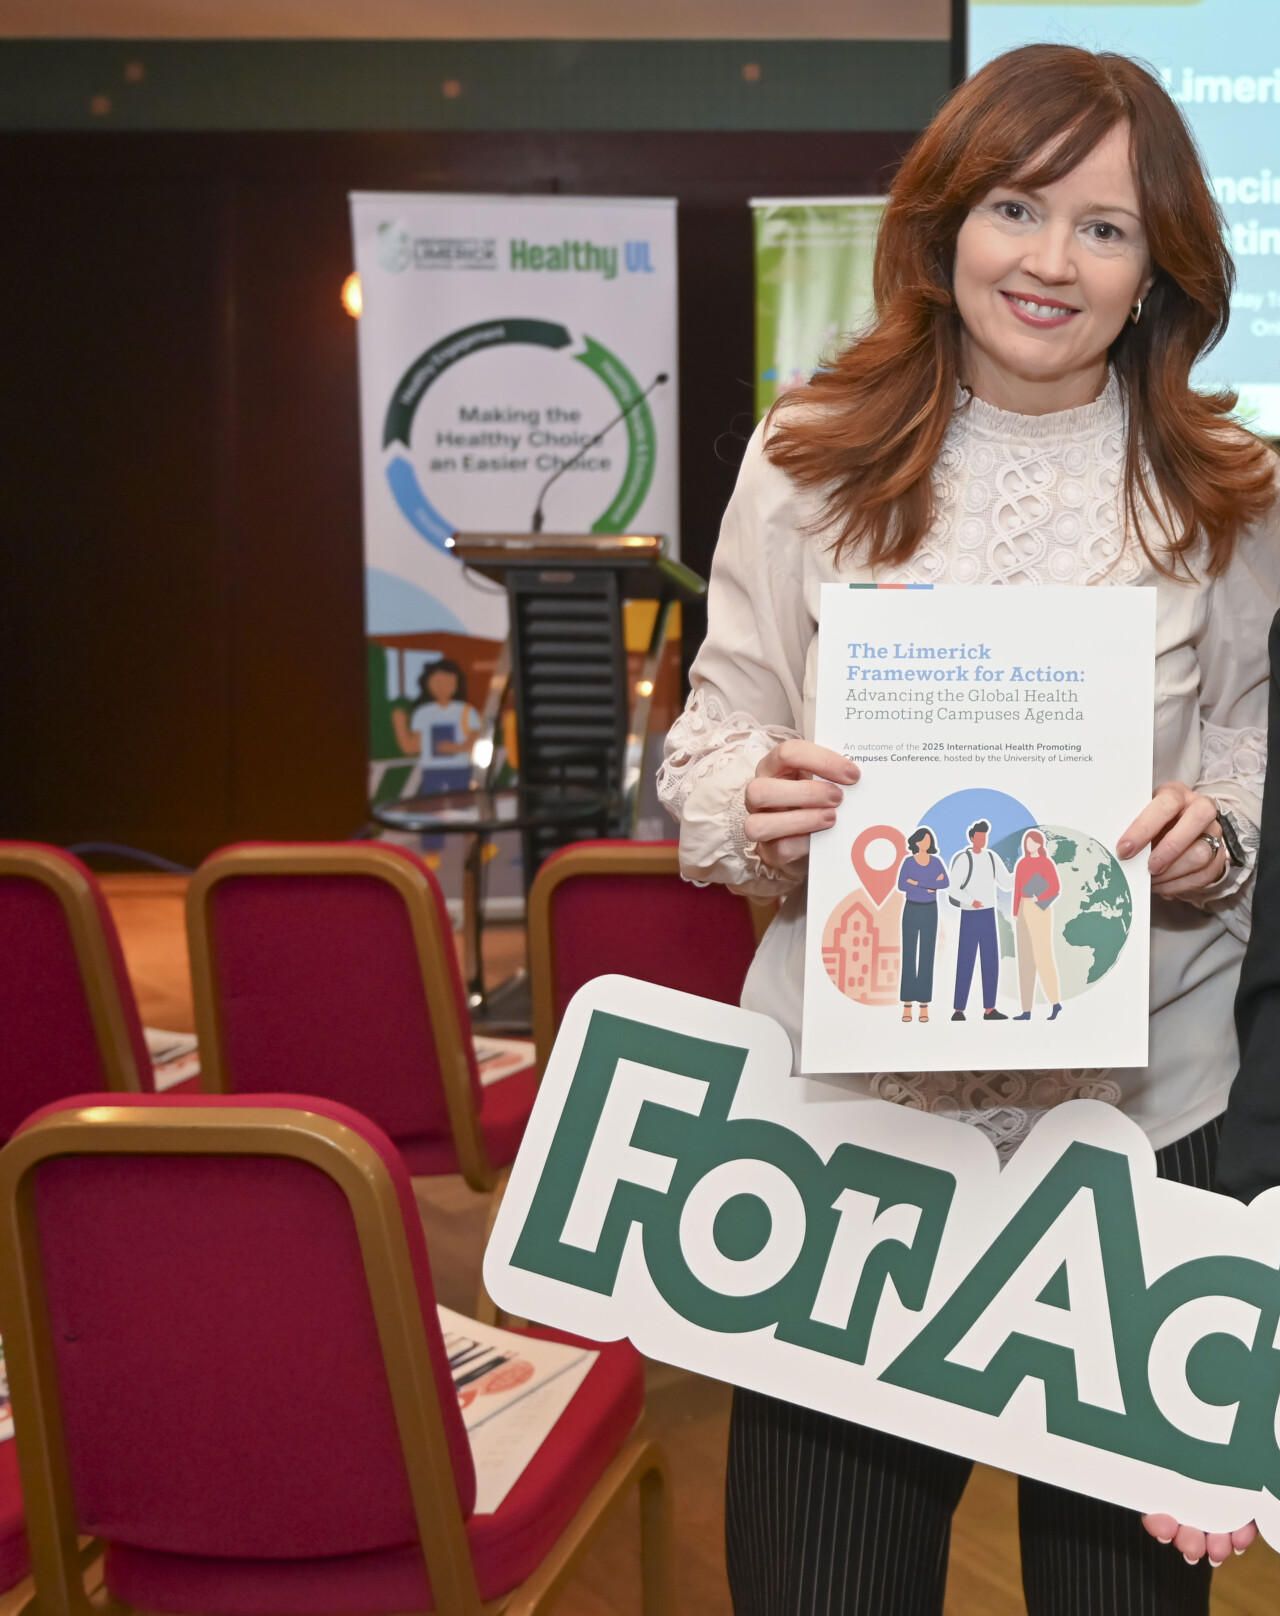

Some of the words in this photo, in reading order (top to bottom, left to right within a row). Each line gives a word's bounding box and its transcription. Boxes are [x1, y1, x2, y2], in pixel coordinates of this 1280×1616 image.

[509, 239, 618, 280] Healthy
[624, 240, 656, 272] UL
[458, 407, 540, 426] Making
[546, 406, 581, 423] the
[436, 431, 521, 449] Healthy
[528, 431, 603, 447] Choice
[430, 457, 456, 472] an
[463, 455, 528, 472] Easier
[536, 455, 612, 472] Choice
[847, 642, 889, 659] The
[893, 642, 992, 660] Limerick
[846, 665, 969, 682] Framework
[974, 665, 1005, 682] for
[1009, 665, 1086, 683] Action:
[846, 688, 935, 706] Advancing
[937, 688, 965, 702] the
[968, 689, 1020, 702] Global
[1024, 689, 1079, 703] Health
[844, 706, 934, 724] Promoting
[937, 707, 1020, 724] Campuses
[1024, 707, 1085, 724] Agenda
[843, 742, 856, 751] An
[857, 743, 893, 751] outcome
[896, 742, 904, 751] of
[905, 742, 920, 751] the
[922, 742, 945, 751] 2025
[947, 742, 1003, 752] International
[1005, 743, 1035, 752] Health
[1037, 743, 1082, 753] Promoting
[890, 753, 942, 763] Conference,
[944, 754, 973, 763] hosted
[975, 754, 986, 764] by
[988, 754, 1002, 763] the
[1004, 754, 1046, 764] University
[1049, 754, 1057, 763] of
[1059, 754, 1094, 763] Limerick
